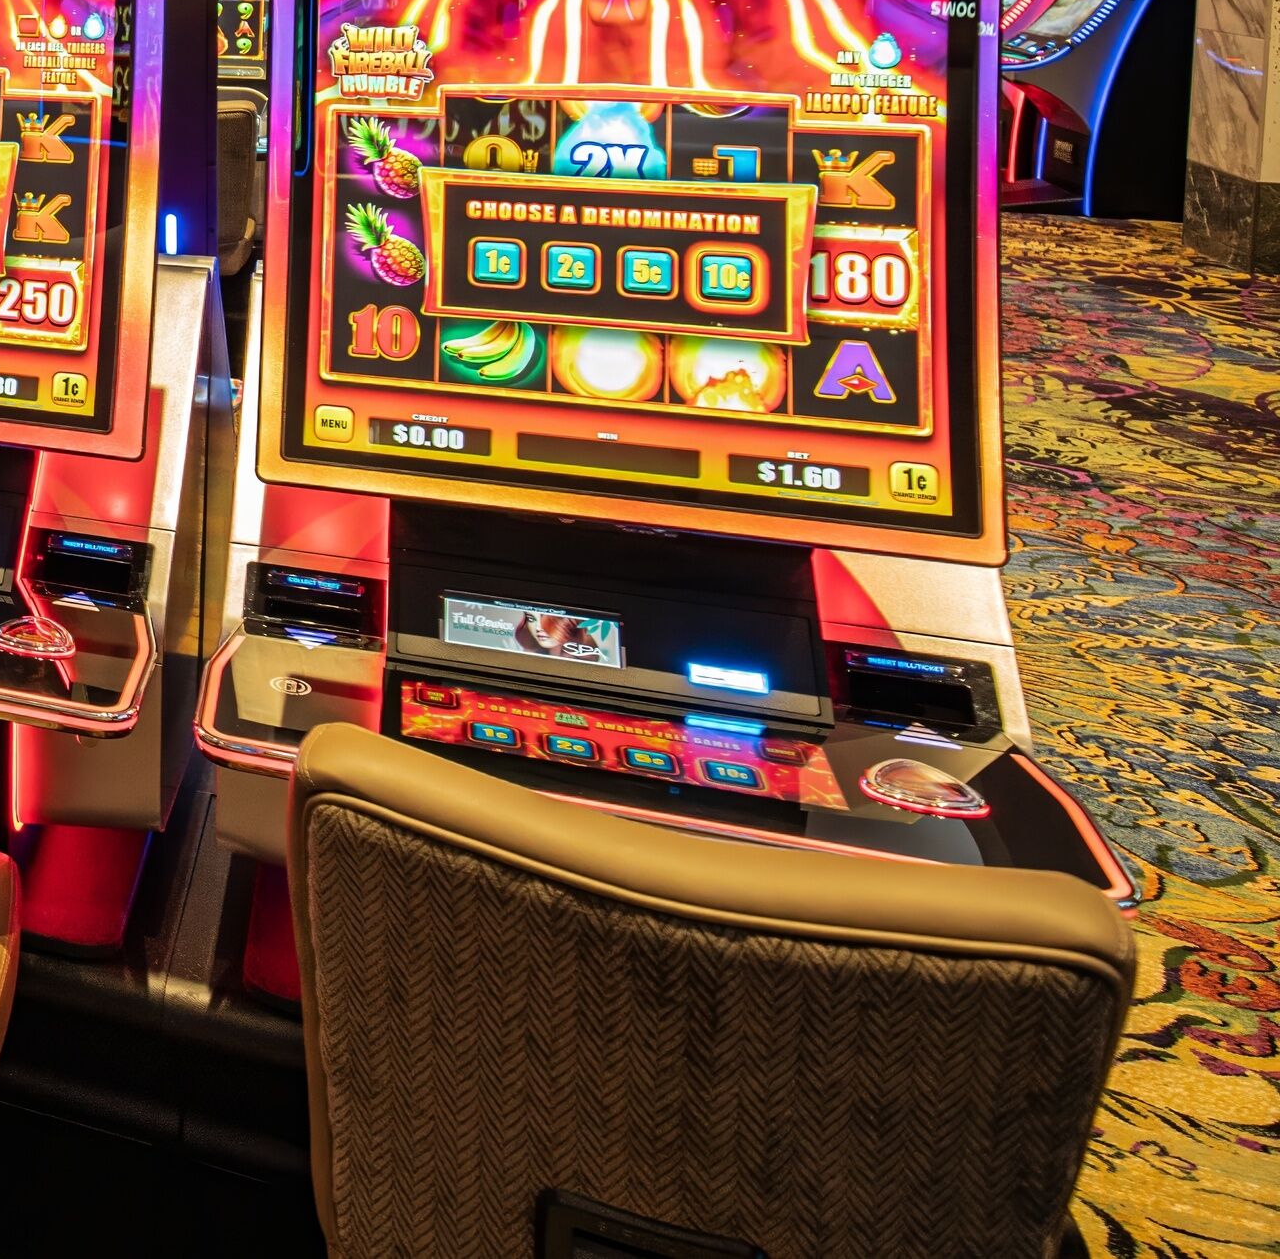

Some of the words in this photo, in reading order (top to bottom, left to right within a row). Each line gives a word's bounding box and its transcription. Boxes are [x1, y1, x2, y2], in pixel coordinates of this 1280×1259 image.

[67, 42, 106, 54] TRIGGERS
[345, 25, 413, 52] WILD
[23, 55, 61, 68] FIREBALL
[63, 56, 97, 69] RUMBLE
[334, 49, 433, 78] FIREBALL
[836, 51, 862, 64] ANY
[41, 71, 77, 84] FEATURE
[342, 74, 421, 98] RUMBLE
[830, 73, 855, 87] MAY
[857, 74, 912, 89] TRIGGER
[805, 92, 870, 114] JACKPOT
[874, 94, 938, 117] FEATURE
[465, 200, 556, 224] CHOOSE
[559, 205, 578, 225] A
[581, 206, 761, 235] DENOMINATION
[484, 249, 511, 274] 1¢
[557, 253, 585, 279] 2¢
[632, 258, 663, 284] 5¢
[704, 263, 751, 291] 10¢
[809, 252, 912, 306] 180
[348, 302, 420, 361] 10
[61, 376, 80, 397] 1¢
[321, 417, 348, 430] MENU
[411, 413, 449, 423] CREDIT
[392, 423, 465, 450] $0.00
[786, 451, 811, 460] BET
[757, 462, 841, 491] $1.60
[903, 468, 927, 492] 1¢
[287, 577, 317, 587] COLLECT
[452, 611, 477, 626] Full
[477, 615, 515, 631] Service
[562, 641, 609, 661] SPA
[511, 708, 547, 720] MORE
[595, 722, 652, 736] AWARDS
[656, 730, 689, 743] FREE
[692, 736, 742, 750] GAMES
